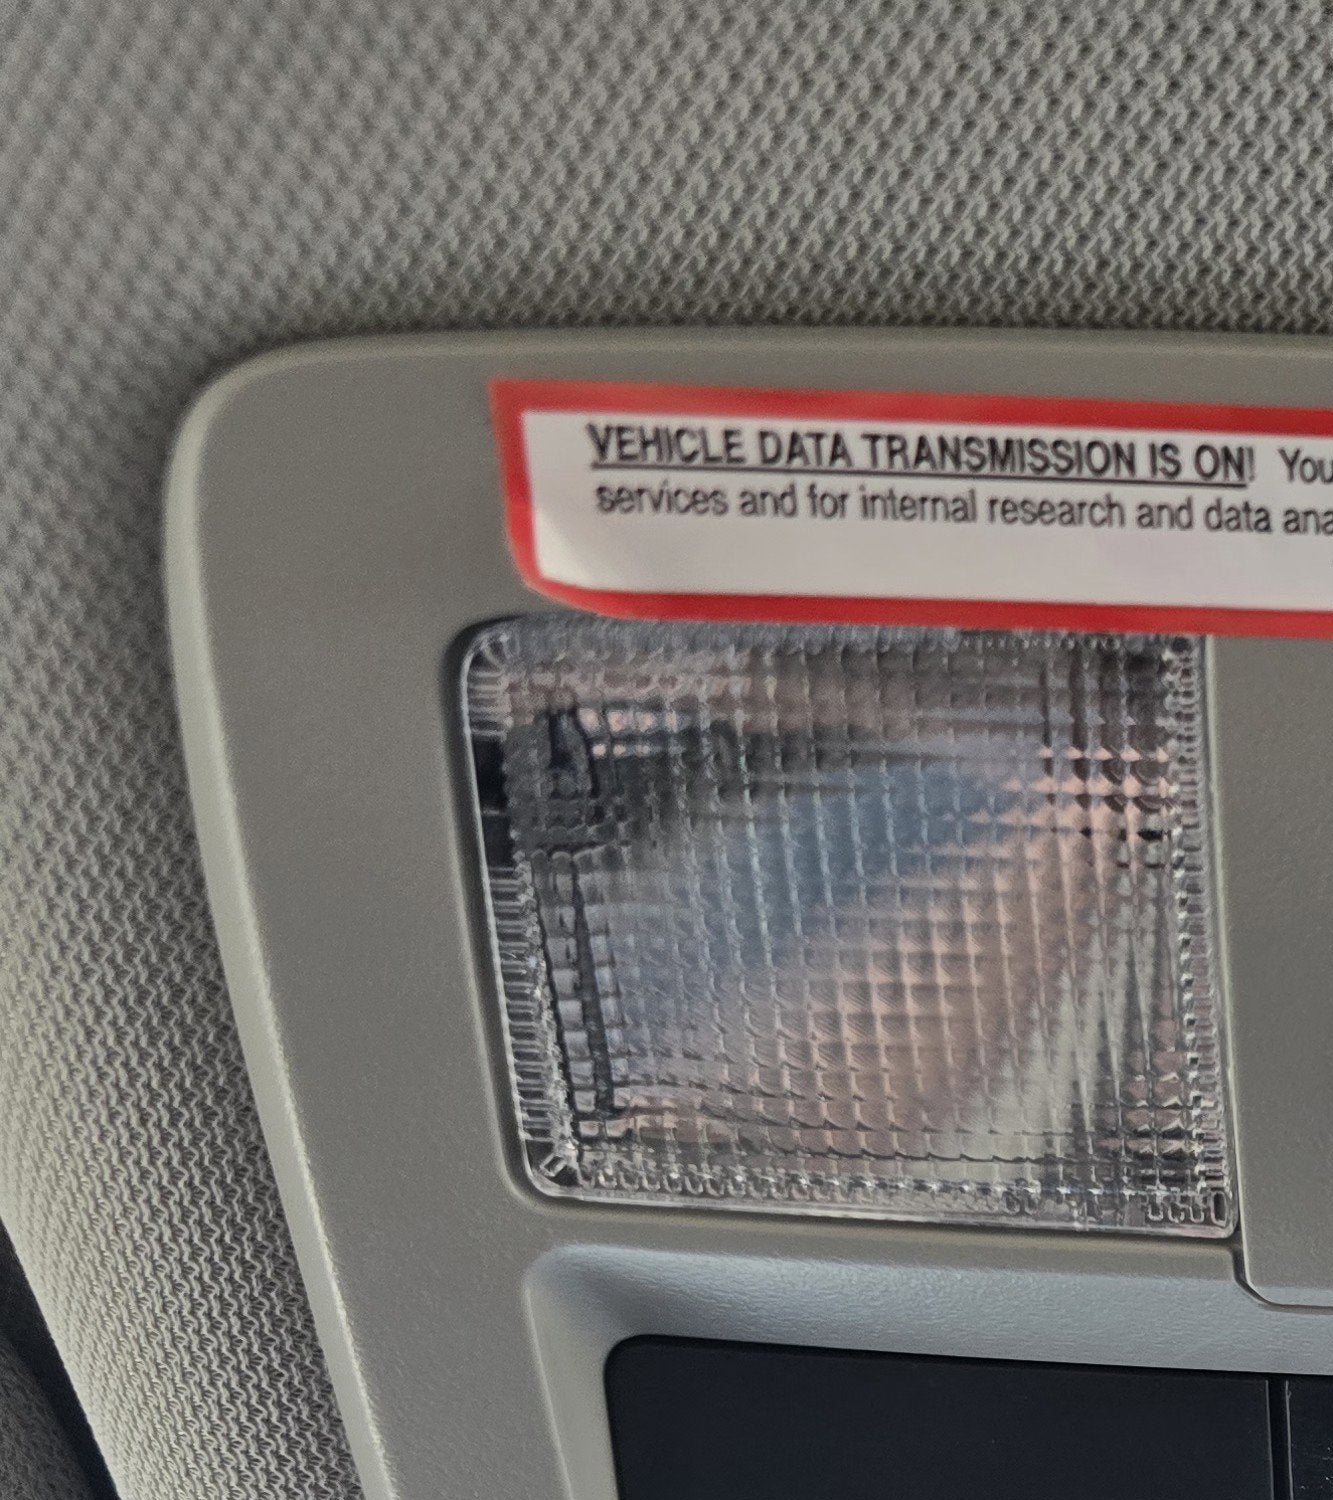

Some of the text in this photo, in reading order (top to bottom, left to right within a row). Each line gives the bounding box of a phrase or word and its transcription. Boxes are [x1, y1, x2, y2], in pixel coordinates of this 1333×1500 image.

[588, 423, 746, 465] VEHICLE
[758, 430, 854, 468] DATA
[861, 433, 1136, 479] TRANSMISSION
[1149, 442, 1182, 479] IS
[1194, 445, 1256, 482] ON!
[596, 480, 728, 515] services
[739, 484, 797, 517] and
[807, 484, 848, 518] for
[861, 488, 976, 524] internal
[988, 493, 1125, 528] research
[1137, 498, 1193, 530] and
[1205, 498, 1273, 533] data
